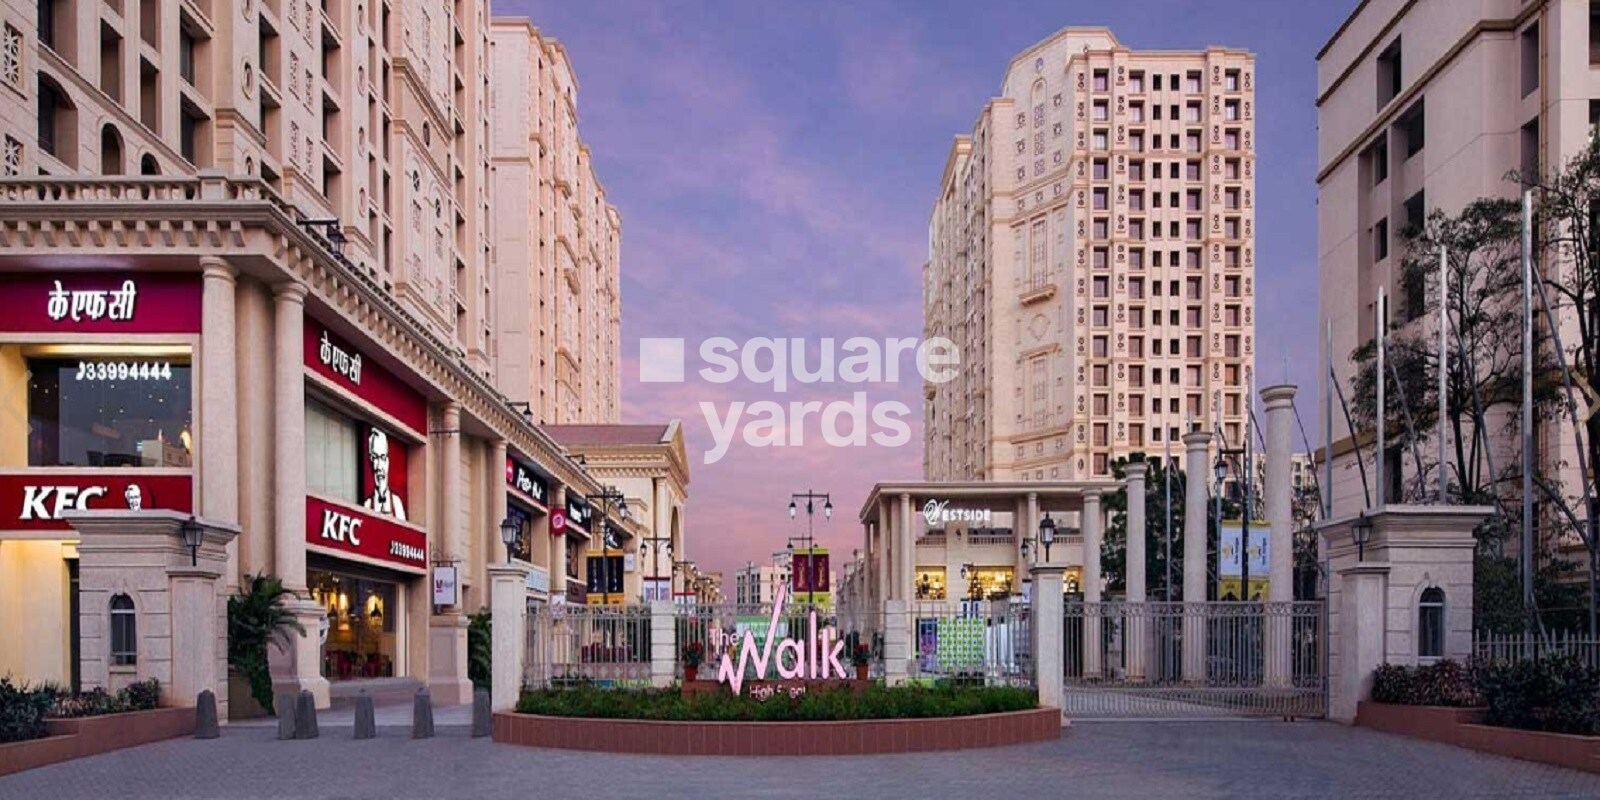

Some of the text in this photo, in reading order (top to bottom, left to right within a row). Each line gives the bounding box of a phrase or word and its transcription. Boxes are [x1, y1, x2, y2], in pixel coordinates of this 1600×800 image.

[86, 361, 172, 381] 33994444
[19, 485, 105, 520] KFC
[321, 509, 362, 546] KFC
[709, 628, 739, 646] The
[718, 580, 847, 696] Walk
[749, 683, 774, 701] High
